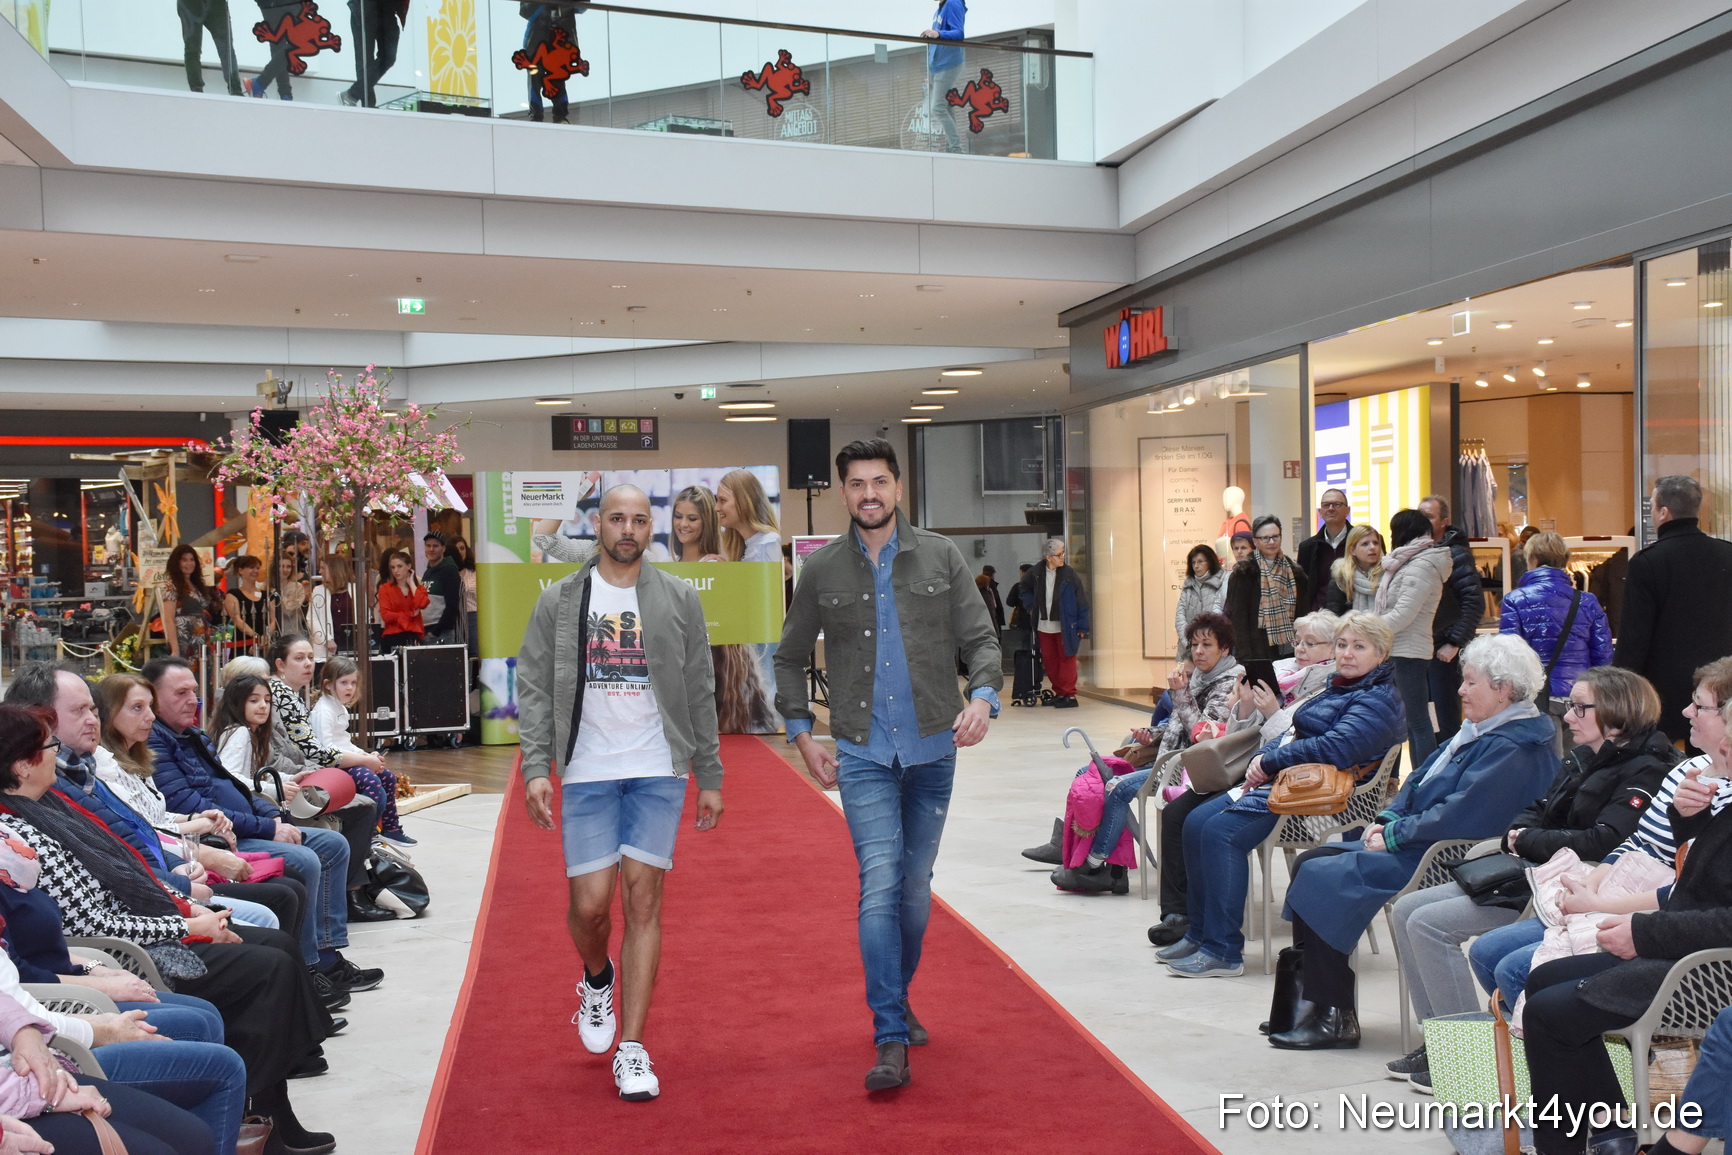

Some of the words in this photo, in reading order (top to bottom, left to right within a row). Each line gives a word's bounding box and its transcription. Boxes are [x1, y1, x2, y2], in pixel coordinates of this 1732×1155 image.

[785, 108, 812, 122] MITTAGS
[780, 120, 817, 138] ANGEBOT
[1103, 306, 1168, 369] WÖHRL
[1154, 453, 1174, 461] finden
[520, 493, 565, 501] NeuerMarkt
[588, 682, 624, 690] ADVENTURE
[625, 682, 653, 690] UNLIMIT
